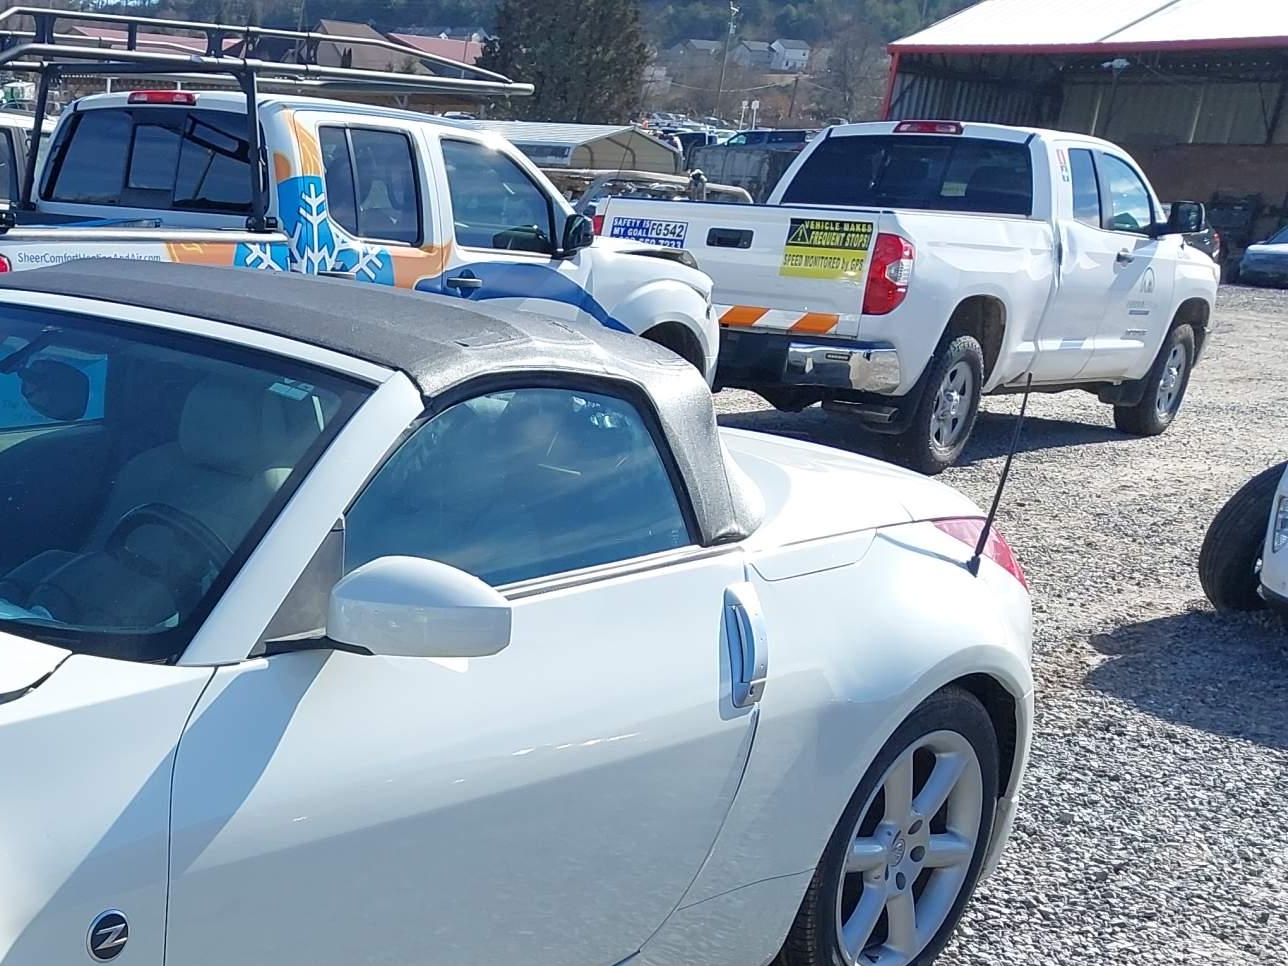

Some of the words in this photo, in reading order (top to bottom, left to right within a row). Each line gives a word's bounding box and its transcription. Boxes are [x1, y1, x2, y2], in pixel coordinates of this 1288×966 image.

[613, 218, 640, 227] SAFETY
[642, 219, 650, 228] IS
[805, 220, 841, 231] VEHICLE
[843, 223, 872, 232] MAKES
[613, 226, 625, 235] MY
[627, 228, 647, 237] GOAL
[649, 222, 684, 238] FG542
[809, 231, 844, 246] FREQUENT
[783, 253, 803, 267] SPEED
[805, 255, 841, 270] MONITORED
[849, 258, 864, 271] GPS
